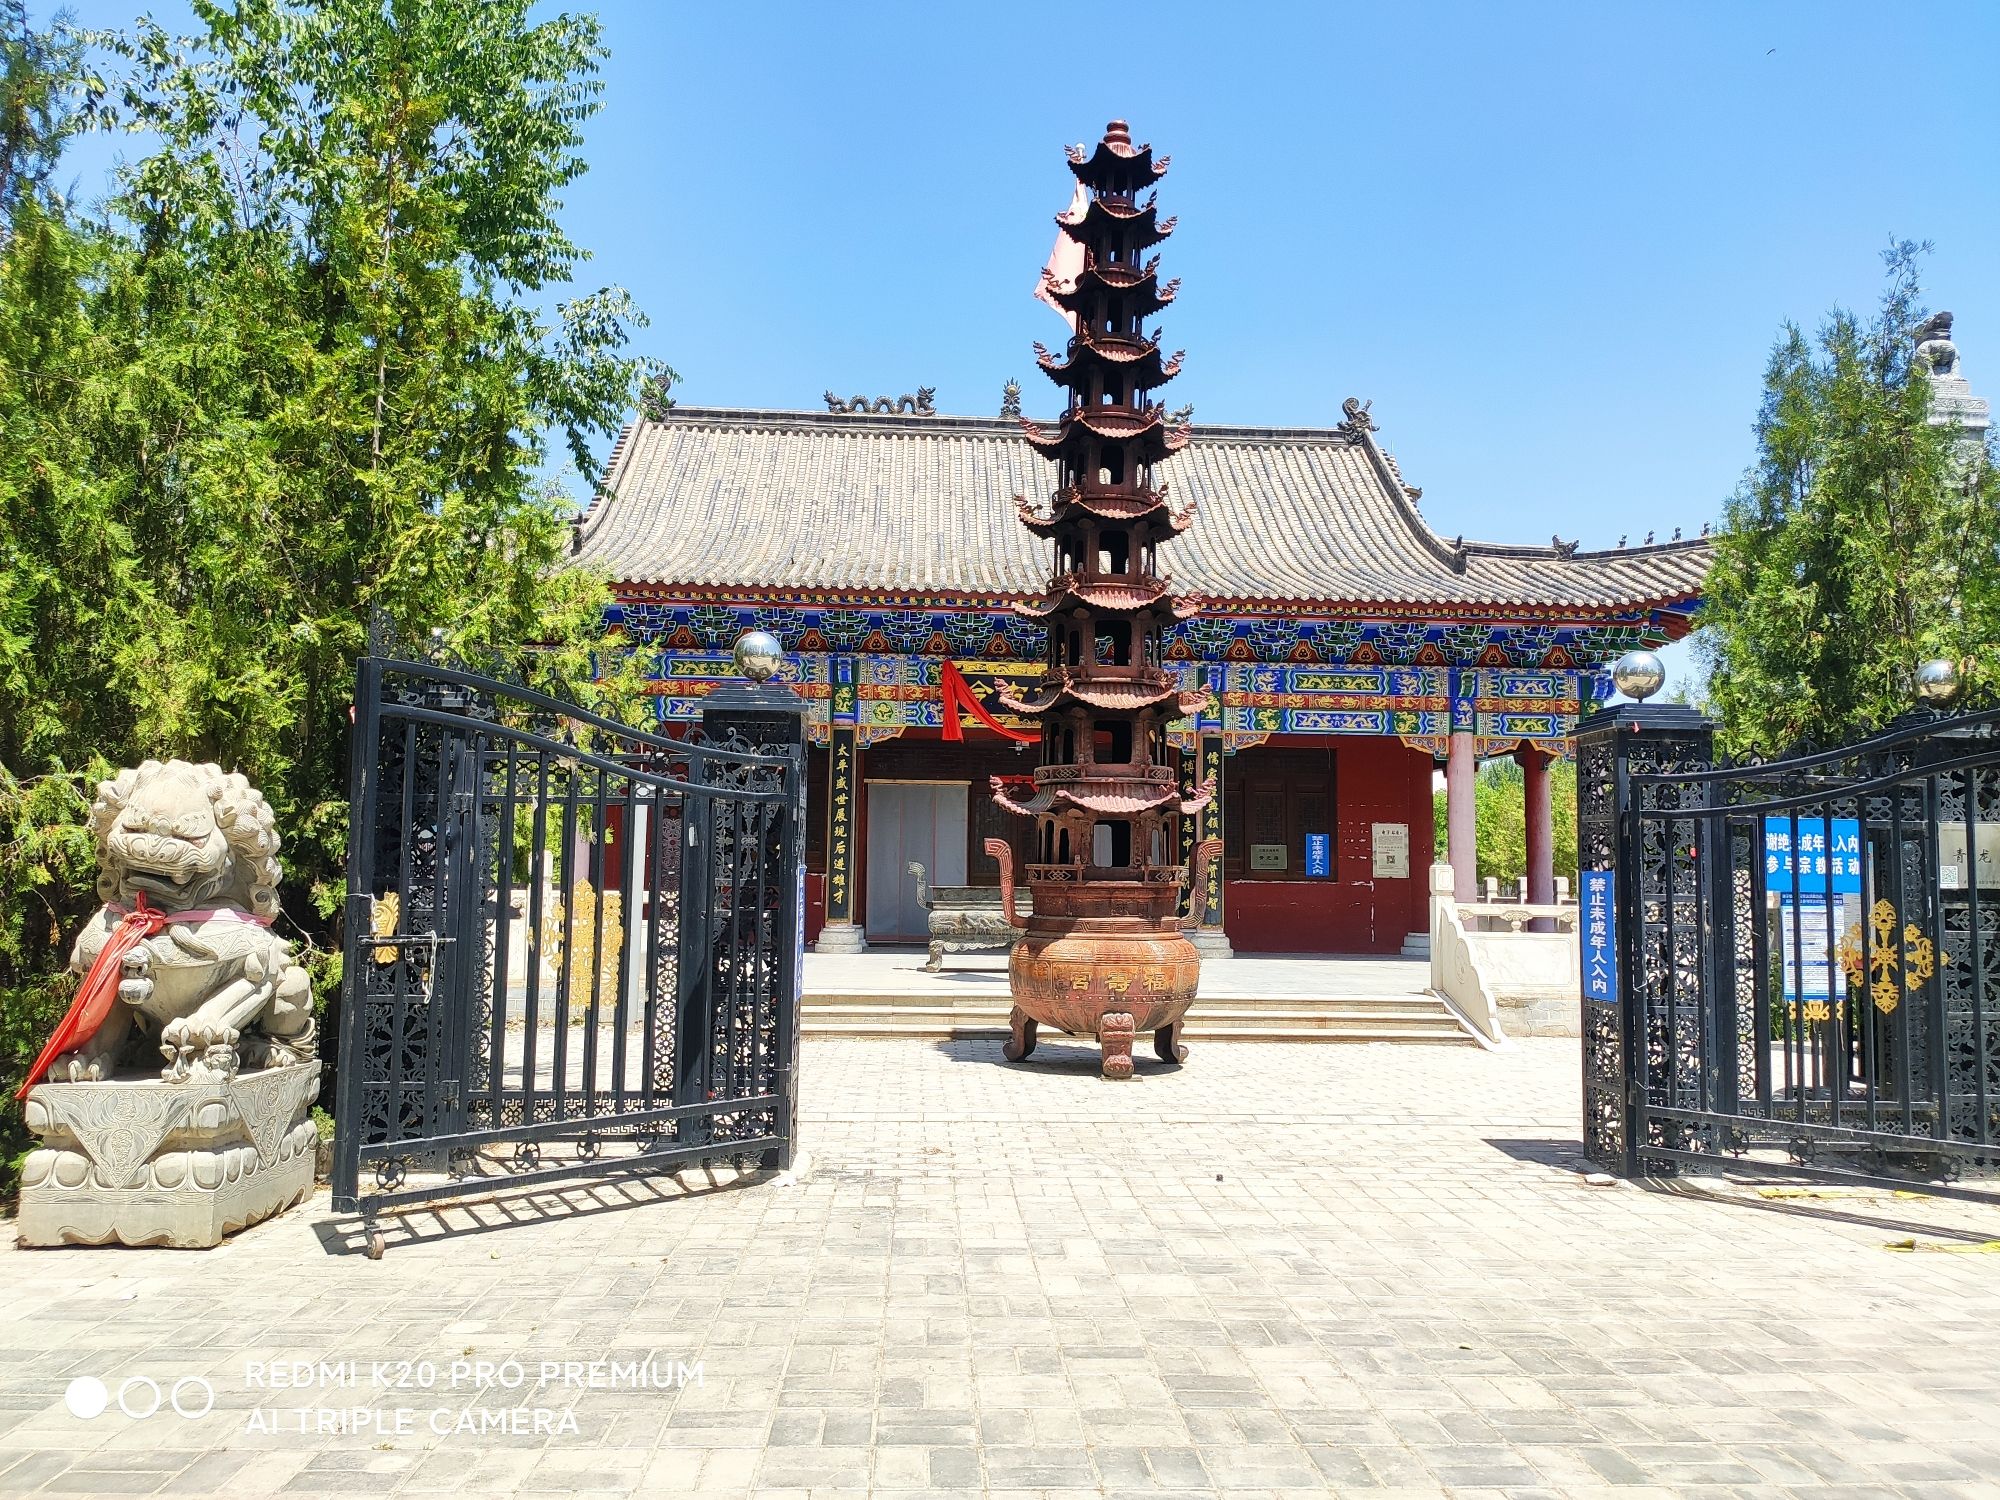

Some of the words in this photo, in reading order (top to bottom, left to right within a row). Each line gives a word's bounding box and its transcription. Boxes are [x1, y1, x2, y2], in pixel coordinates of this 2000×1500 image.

[1766, 832, 1858, 853] 谢绝成年入内
[1766, 854, 1860, 876] 参与宗教活动
[1953, 847, 1992, 864] 青龙
[1589, 877, 1608, 994] 禁止未成年人入内
